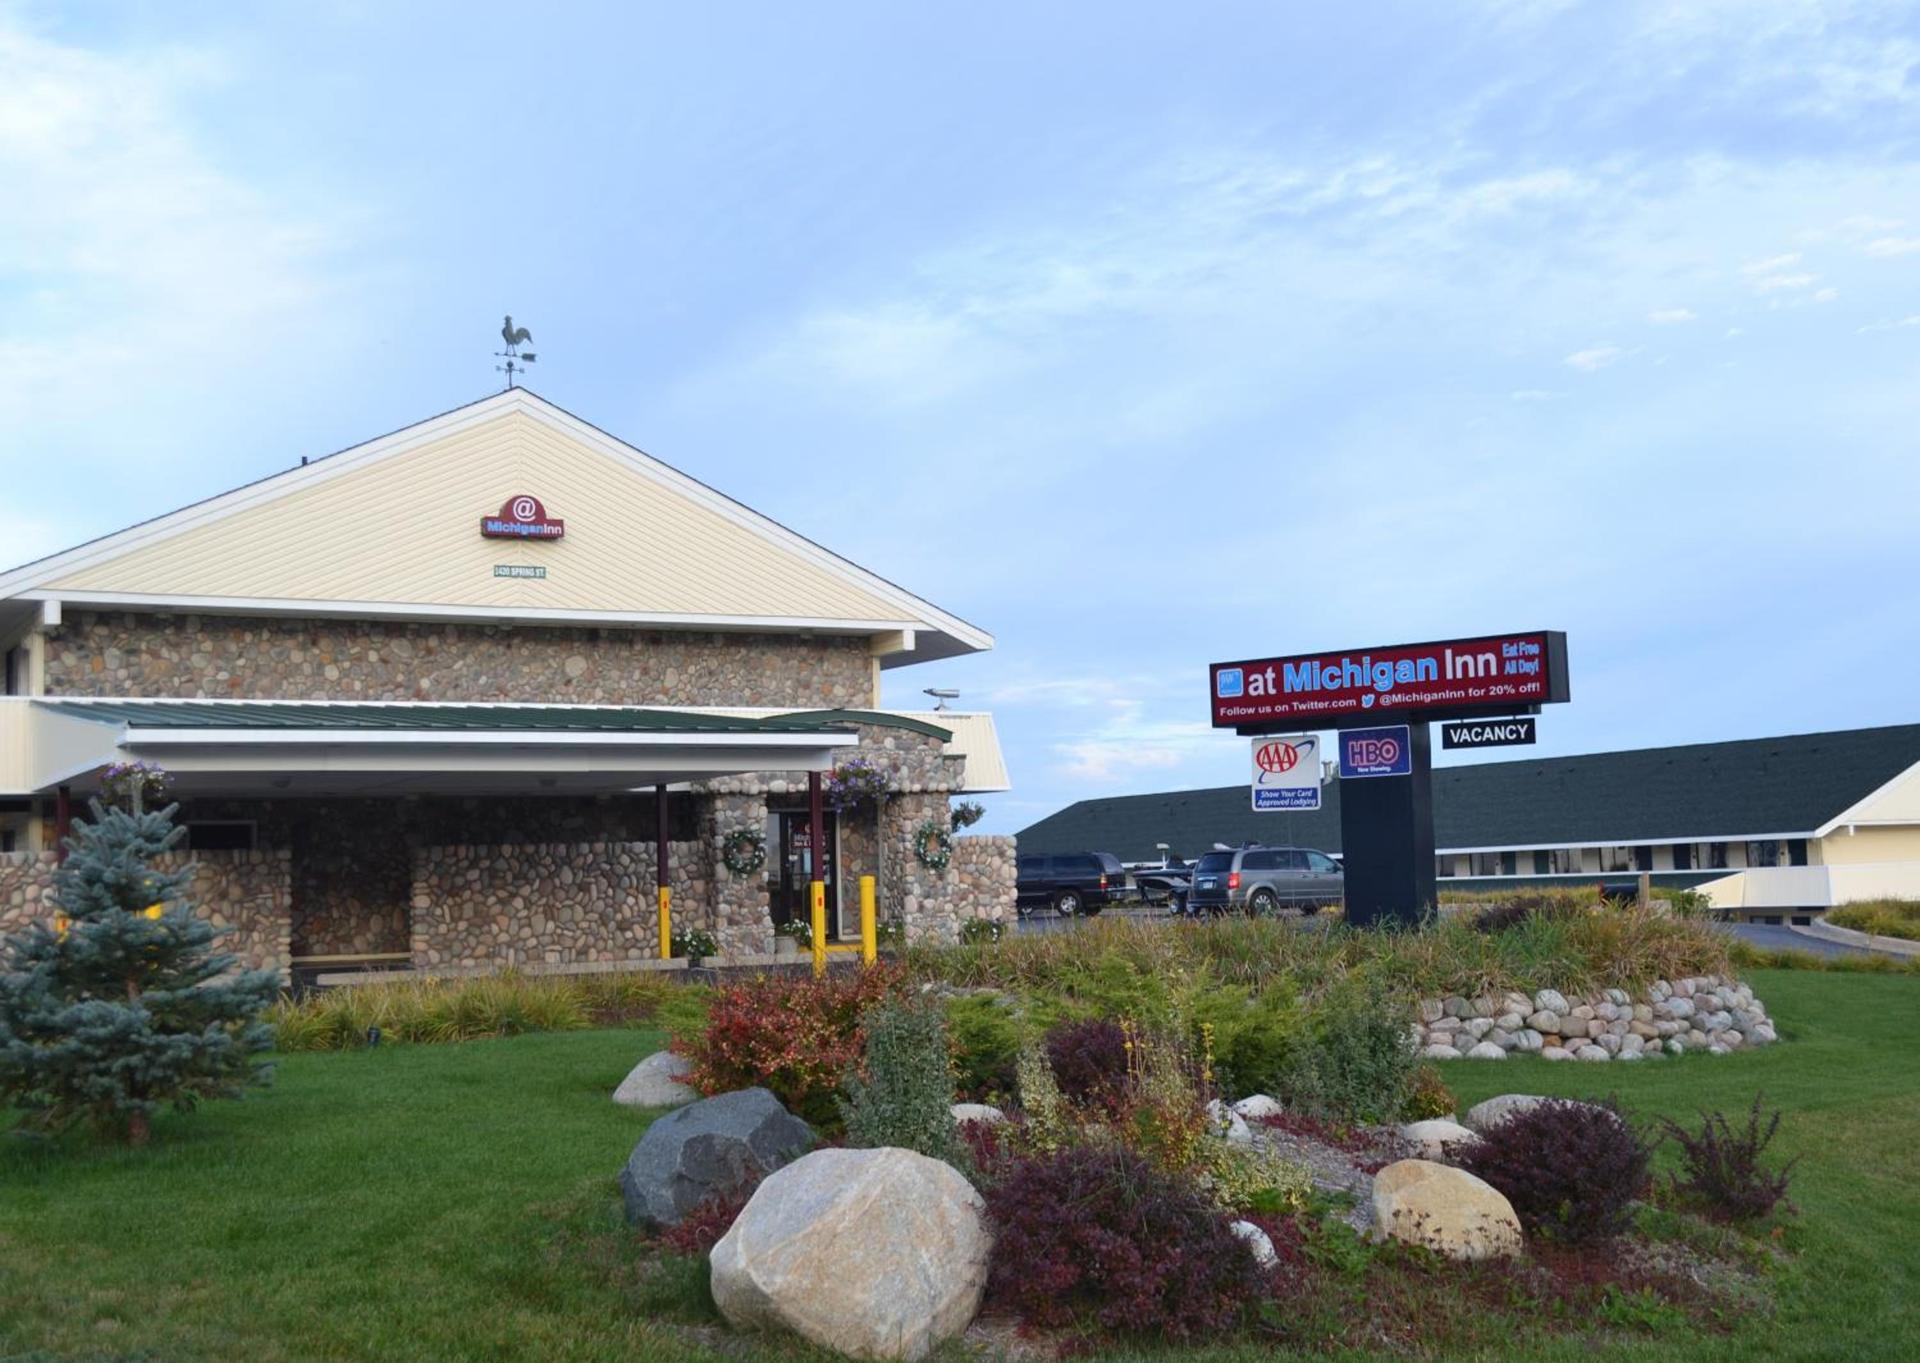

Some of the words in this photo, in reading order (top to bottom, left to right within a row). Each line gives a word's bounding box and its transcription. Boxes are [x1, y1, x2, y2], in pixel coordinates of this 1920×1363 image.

[511, 567, 534, 577] SPRING
[1519, 641, 1540, 656] Free
[1248, 666, 1277, 696] at
[1283, 656, 1438, 692] Michigan
[1445, 648, 1498, 680] Inn
[1504, 660, 1518, 675] All
[1519, 658, 1540, 676] Day!
[1220, 705, 1256, 717] Follow
[1258, 704, 1272, 713] us
[1275, 703, 1289, 712] on
[1291, 698, 1357, 711] Twitter.com
[1380, 689, 1465, 706] @MichiganInn
[1468, 686, 1486, 697] for
[1489, 684, 1515, 696] 20%
[1519, 682, 1540, 693] off!
[1450, 724, 1528, 744] VACANCY
[1258, 742, 1297, 773] AAA
[1349, 738, 1399, 767] HBO
[1257, 798, 1290, 808] Approved
[1290, 798, 1317, 807] Lodging
[1260, 791, 1280, 799] Show
[1281, 790, 1297, 798] Your
[1297, 789, 1313, 797] Card
